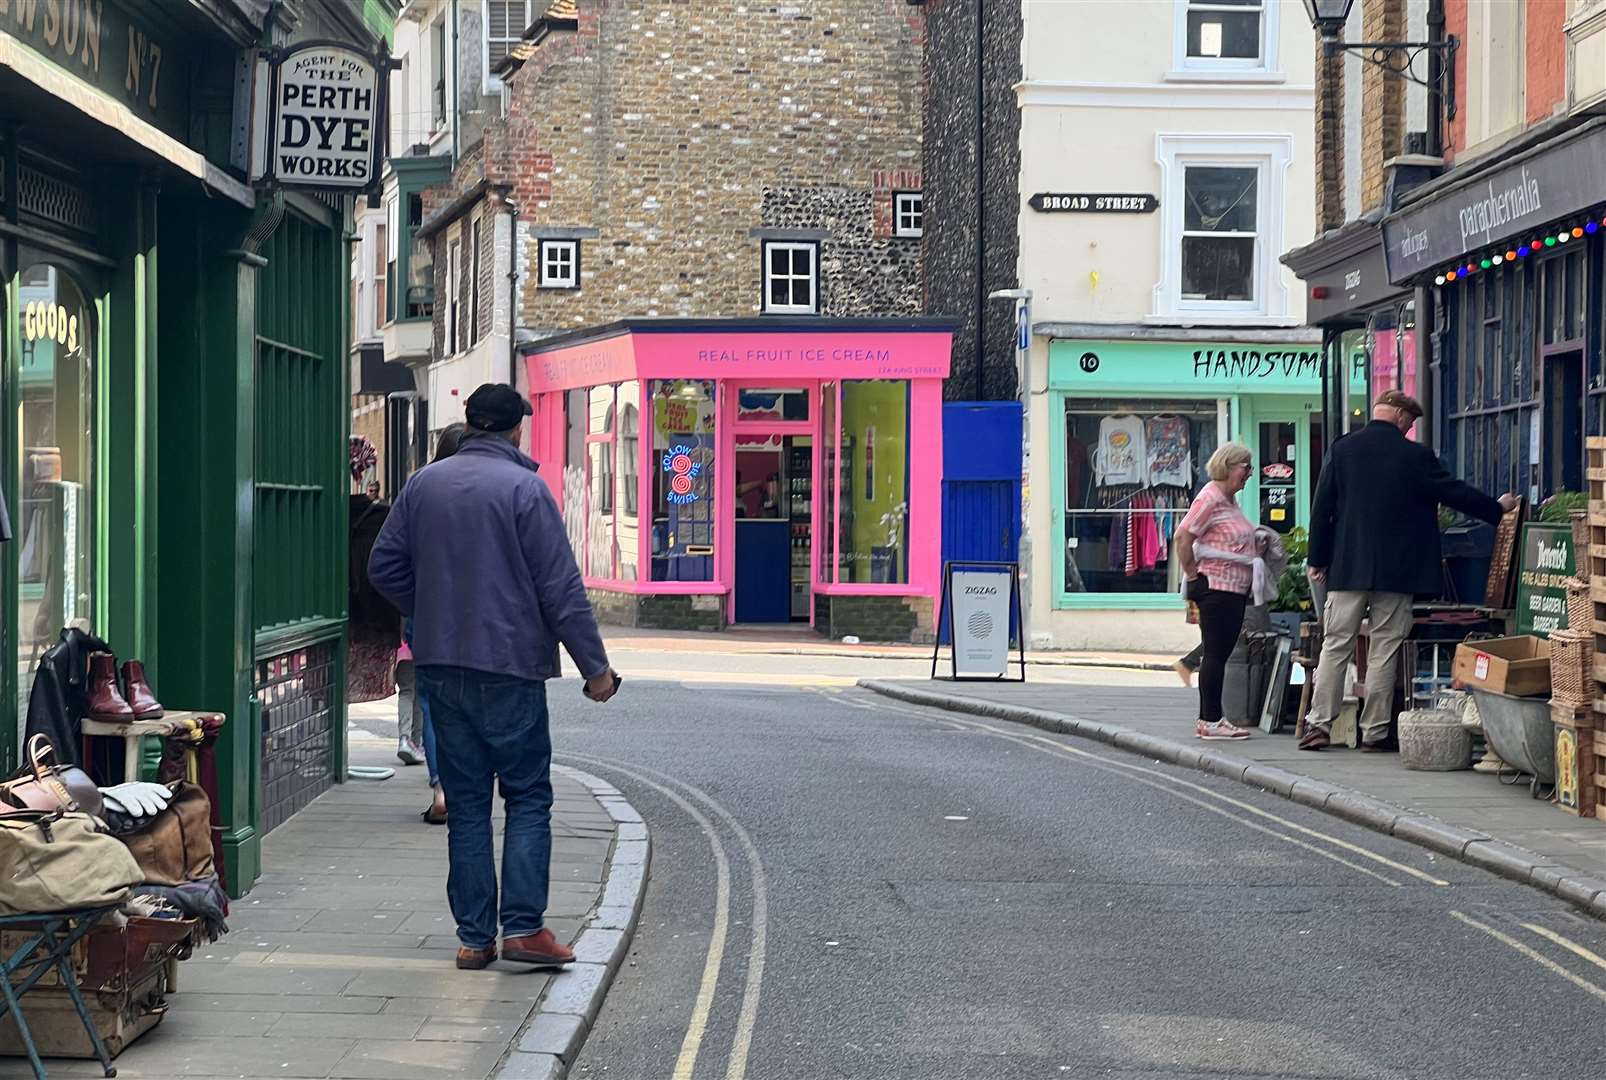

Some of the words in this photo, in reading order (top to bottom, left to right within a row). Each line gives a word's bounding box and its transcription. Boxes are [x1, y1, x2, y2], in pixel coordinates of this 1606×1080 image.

[0, 0, 102, 72] SON
[294, 56, 335, 74] AGENT
[341, 59, 364, 78] FOR
[305, 69, 351, 81] THE
[283, 83, 371, 111] PERTH
[280, 114, 370, 152] DYE
[280, 155, 367, 178] WORKS
[1042, 196, 1090, 209] BROAD
[1095, 196, 1147, 210] STREET
[1459, 165, 1542, 254] paraphernalia
[25, 301, 78, 353] GOODS
[698, 350, 740, 361] REAL
[746, 350, 793, 361] FRUIT
[799, 349, 826, 361] ICE
[832, 349, 890, 361] CREAM
[1082, 356, 1096, 369] 10
[663, 444, 692, 472] FOLLOW
[688, 462, 701, 480] THE
[666, 489, 700, 504] SWIRL
[965, 585, 997, 595] ZIGZAG
[1529, 595, 1542, 610] BEER
[1542, 597, 1562, 613] GARDEN
